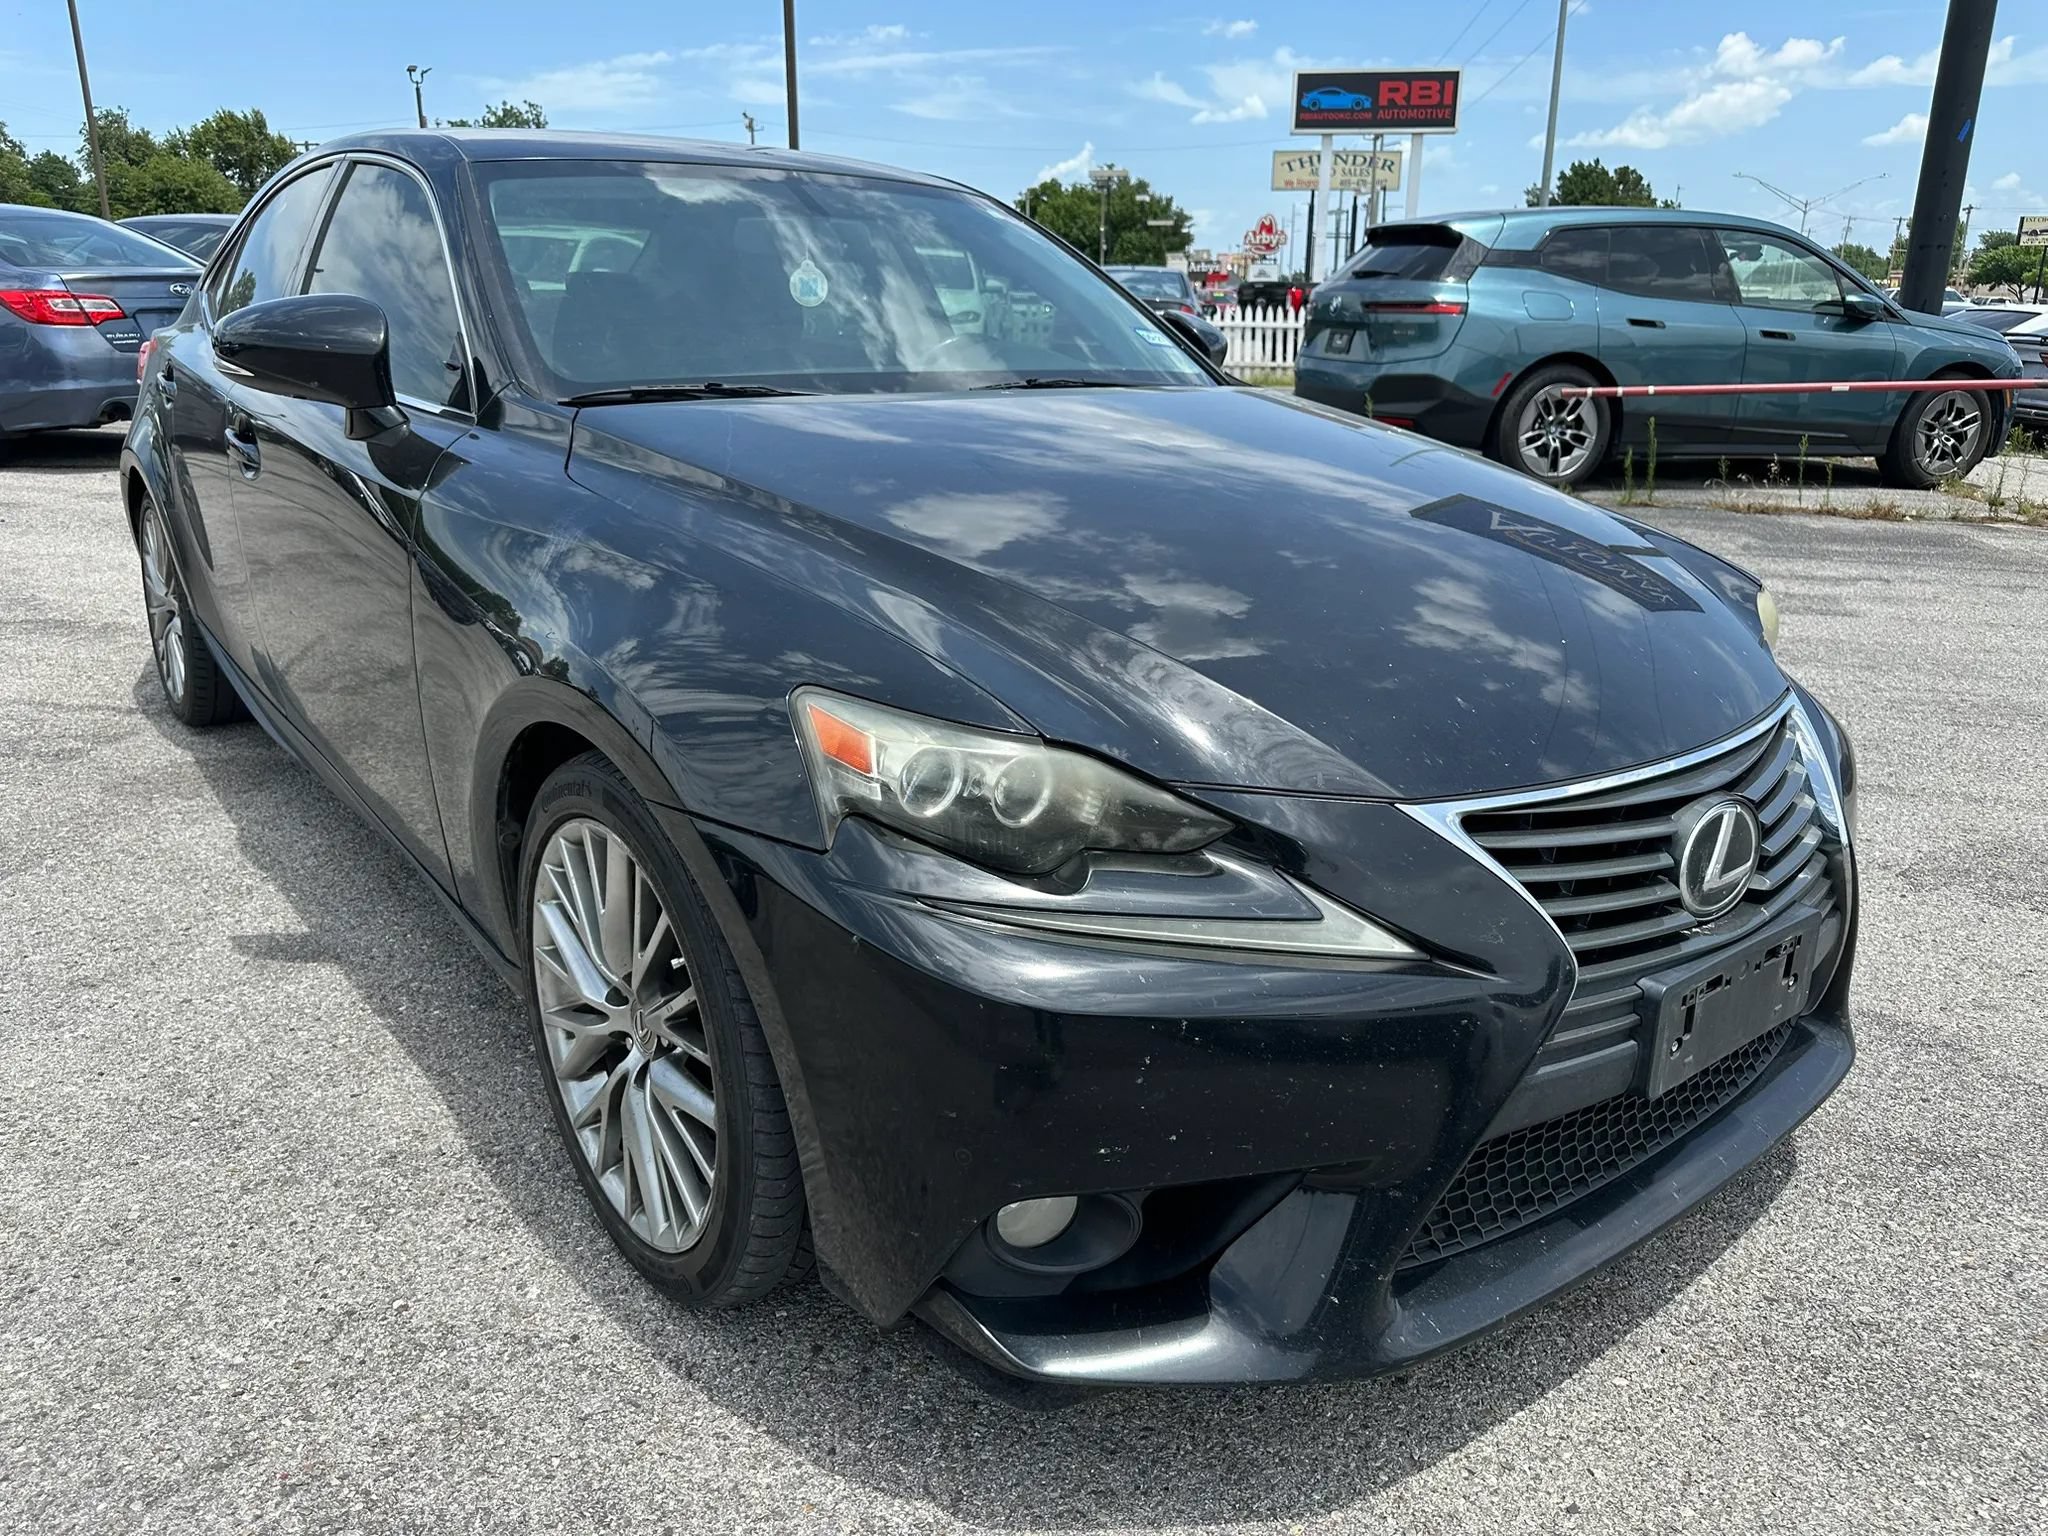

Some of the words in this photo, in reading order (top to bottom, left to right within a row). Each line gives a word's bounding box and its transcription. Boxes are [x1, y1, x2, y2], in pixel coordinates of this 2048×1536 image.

[1378, 80, 1454, 106] RBI
[1377, 108, 1452, 120] AUTOMOTIVE
[1341, 167, 1370, 177] SALES
[1245, 229, 1287, 247] Arby's
